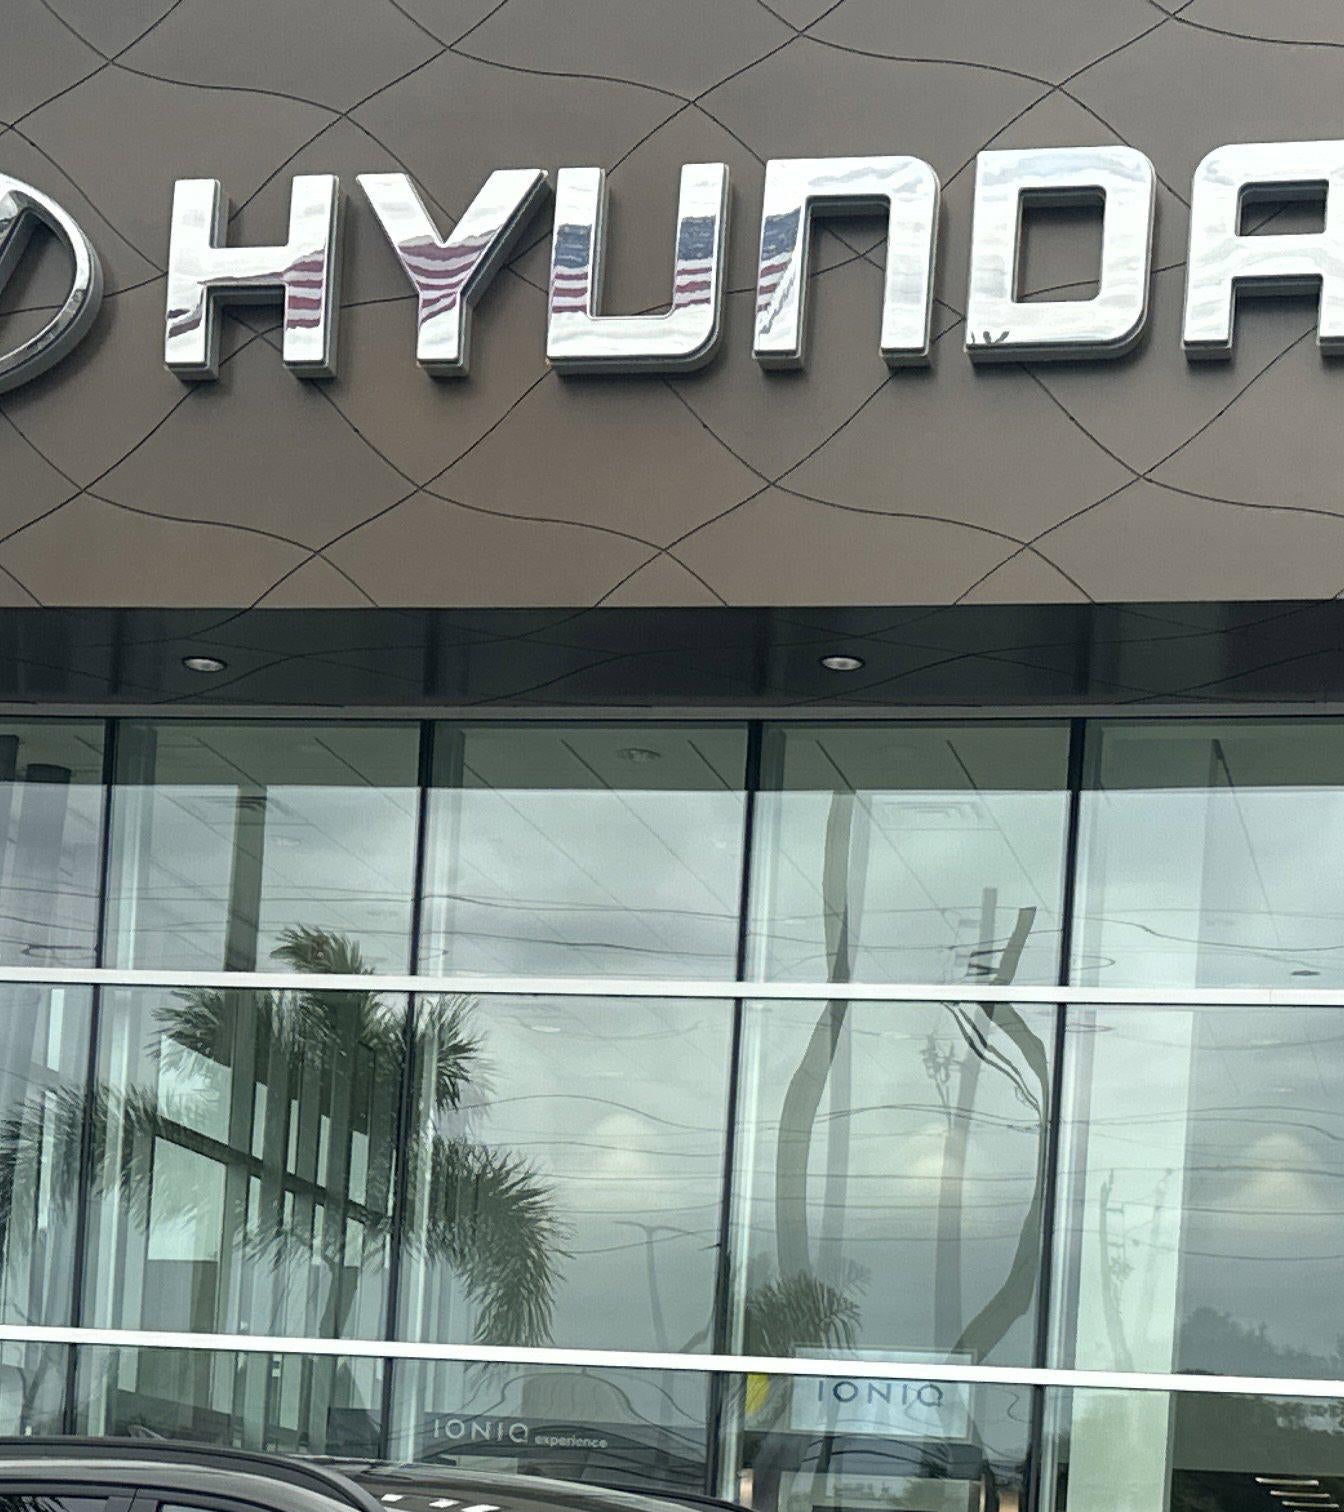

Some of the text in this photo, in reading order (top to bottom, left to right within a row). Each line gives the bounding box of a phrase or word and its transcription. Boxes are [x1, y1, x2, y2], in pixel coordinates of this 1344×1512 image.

[817, 1380, 944, 1408] IONIQ
[432, 1418, 608, 1449] IONIQ experience
